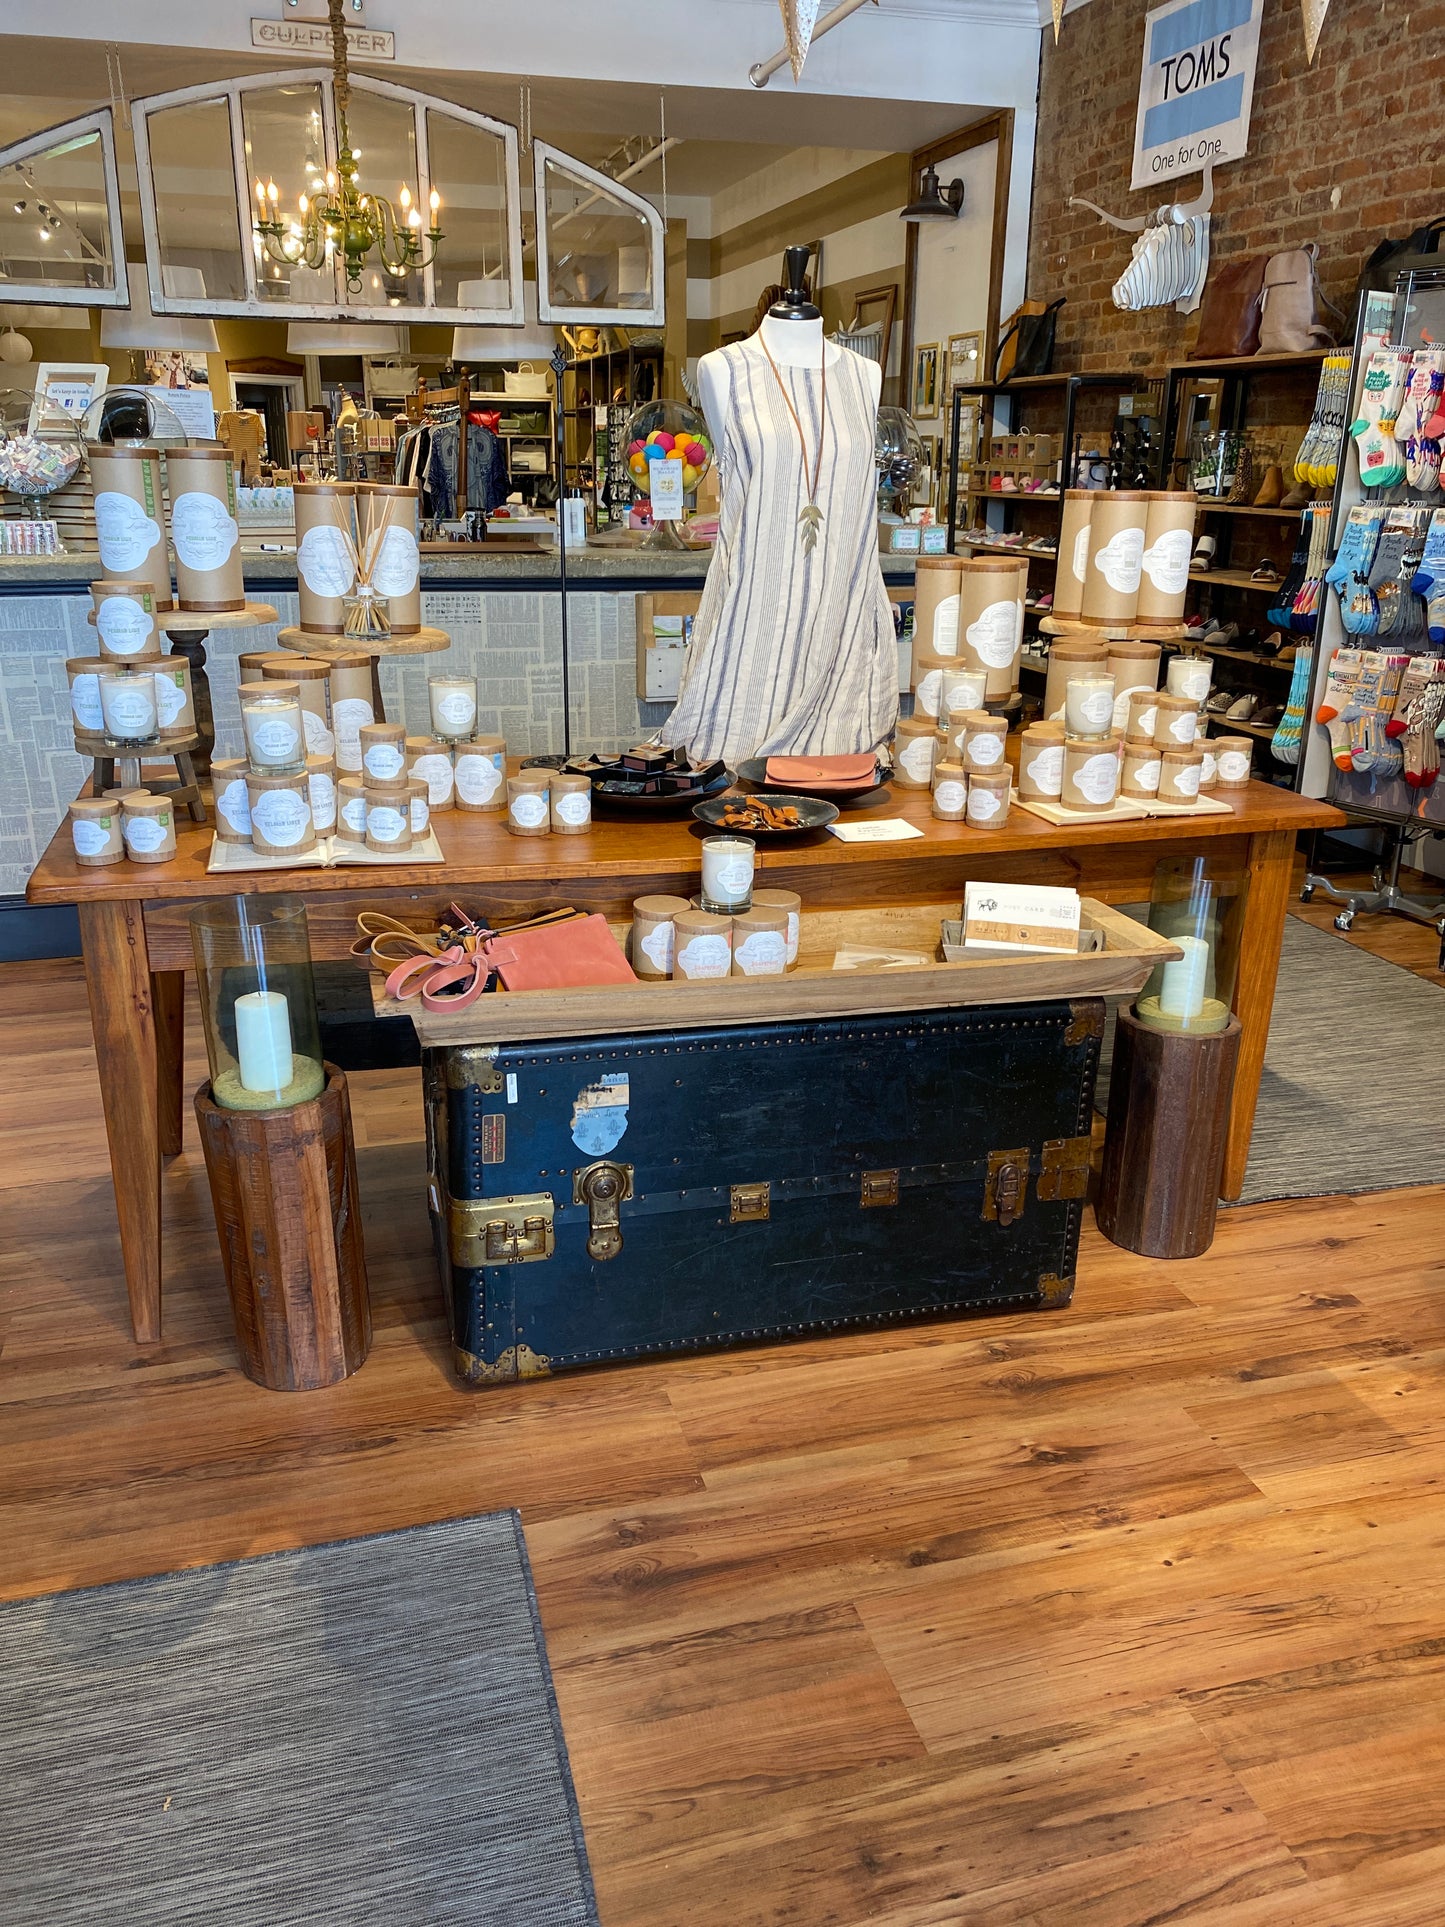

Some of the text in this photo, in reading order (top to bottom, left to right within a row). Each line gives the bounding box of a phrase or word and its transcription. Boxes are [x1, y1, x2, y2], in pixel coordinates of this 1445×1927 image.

[1161, 34, 1231, 100] TOMS
[1152, 139, 1222, 173] One for One
